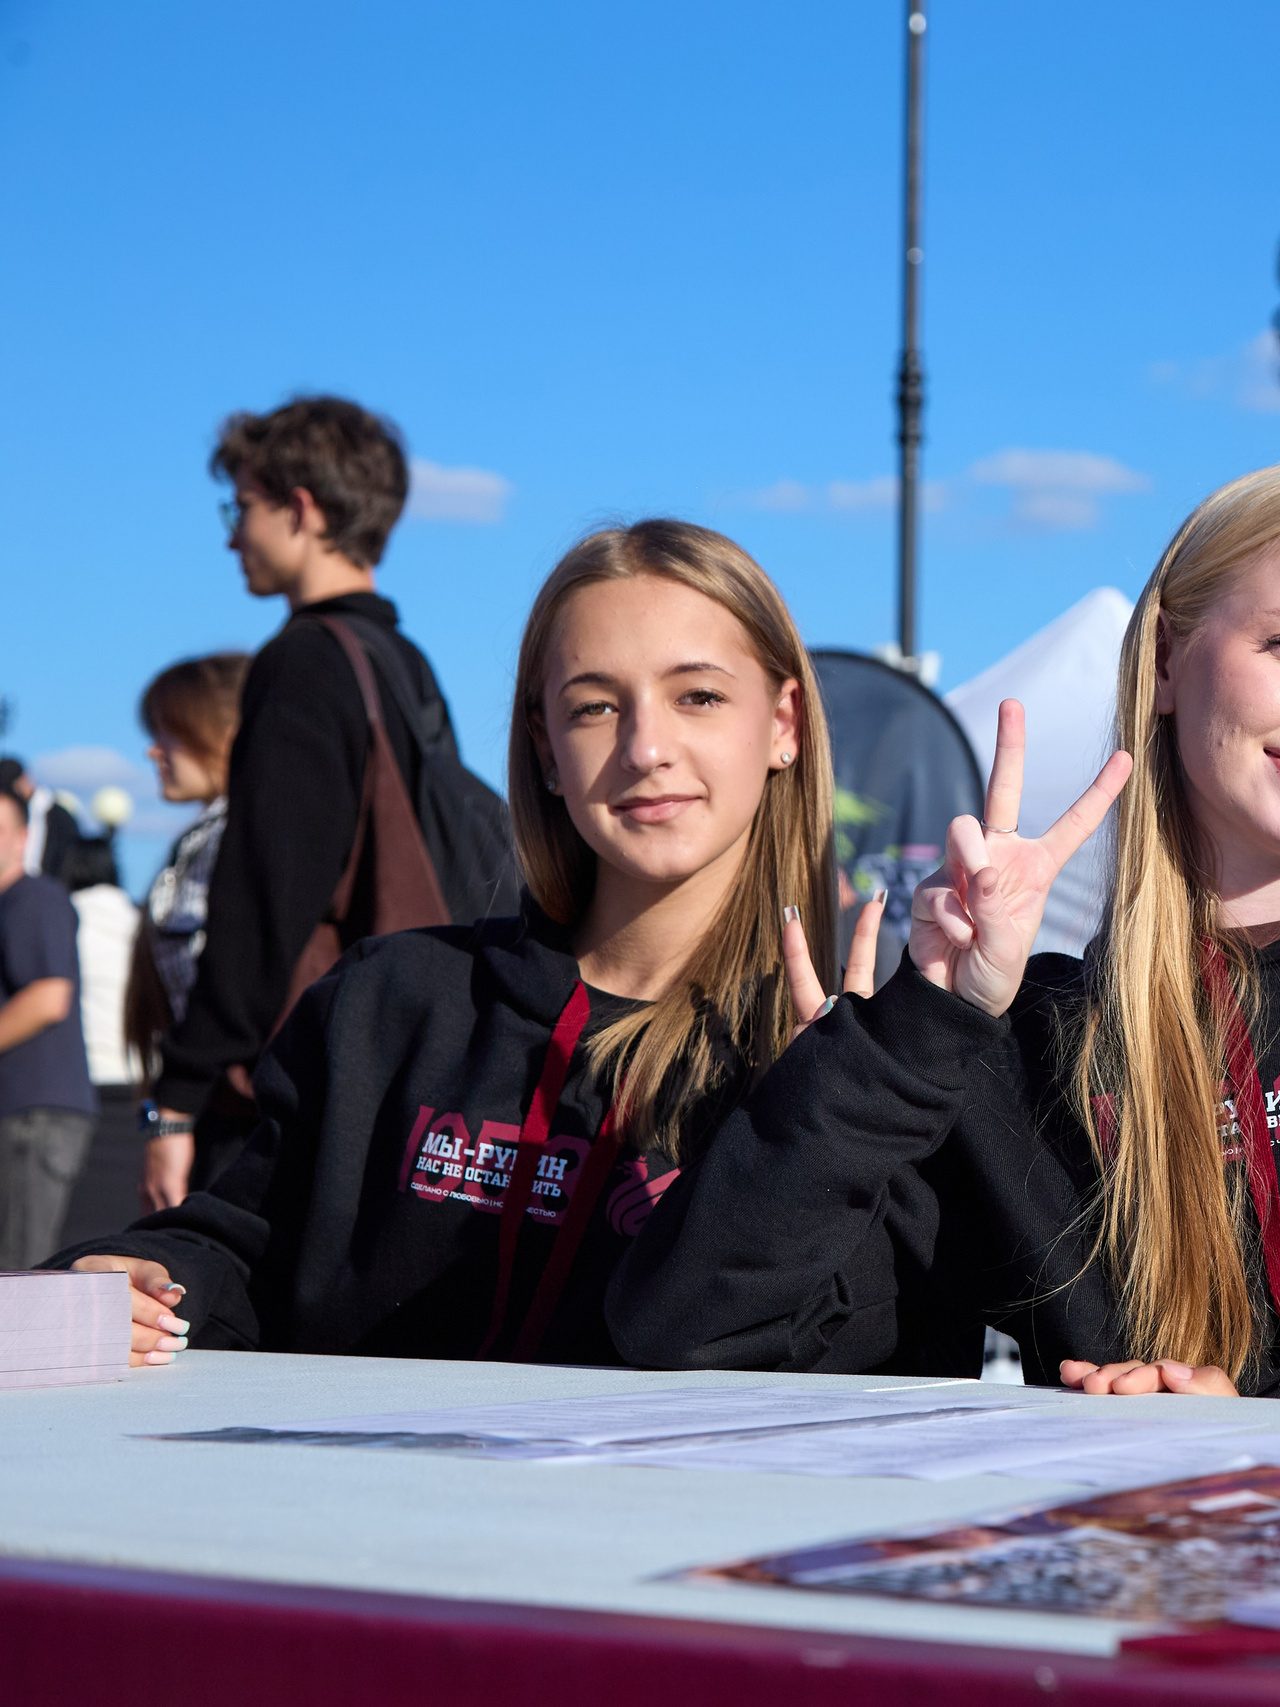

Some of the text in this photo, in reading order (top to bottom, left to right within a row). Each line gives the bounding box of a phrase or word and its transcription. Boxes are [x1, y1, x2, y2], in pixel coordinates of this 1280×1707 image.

[410, 1181, 442, 1196] СДЕЛАНО
[442, 1189, 449, 1197] С
[449, 1191, 490, 1206] ЛЮБОВЬЮ
[416, 1155, 562, 1198] НАС НЕ ОСТАНИТЬ
